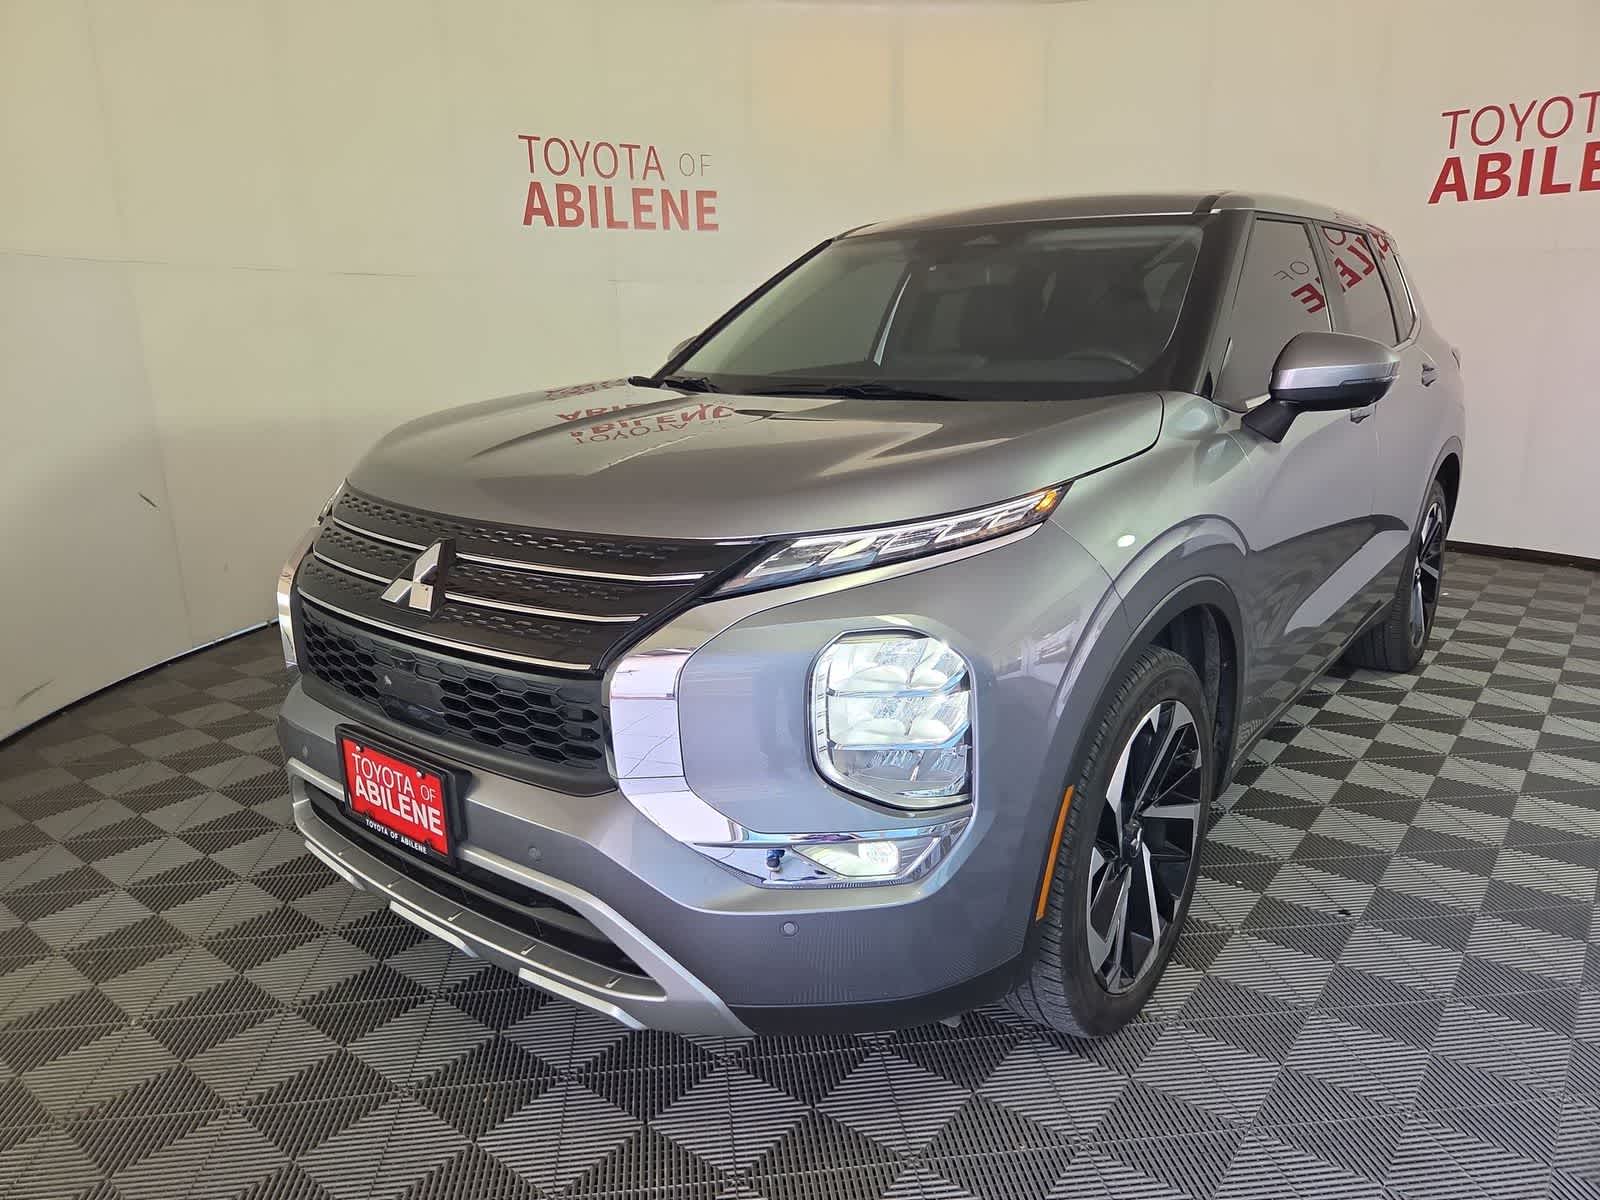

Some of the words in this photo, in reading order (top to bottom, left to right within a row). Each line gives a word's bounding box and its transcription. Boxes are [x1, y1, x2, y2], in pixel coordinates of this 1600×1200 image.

[1441, 91, 1600, 149] TOYOT
[518, 134, 665, 181] TOYOTA
[678, 152, 712, 176] OF
[522, 181, 719, 231] ABILENE
[352, 753, 415, 798] TOYOTA
[420, 785, 436, 803] OF
[355, 776, 443, 836] ABILENE
[366, 819, 388, 835] TOYOTA
[390, 831, 399, 839] OF
[401, 836, 427, 854] ABILENE
